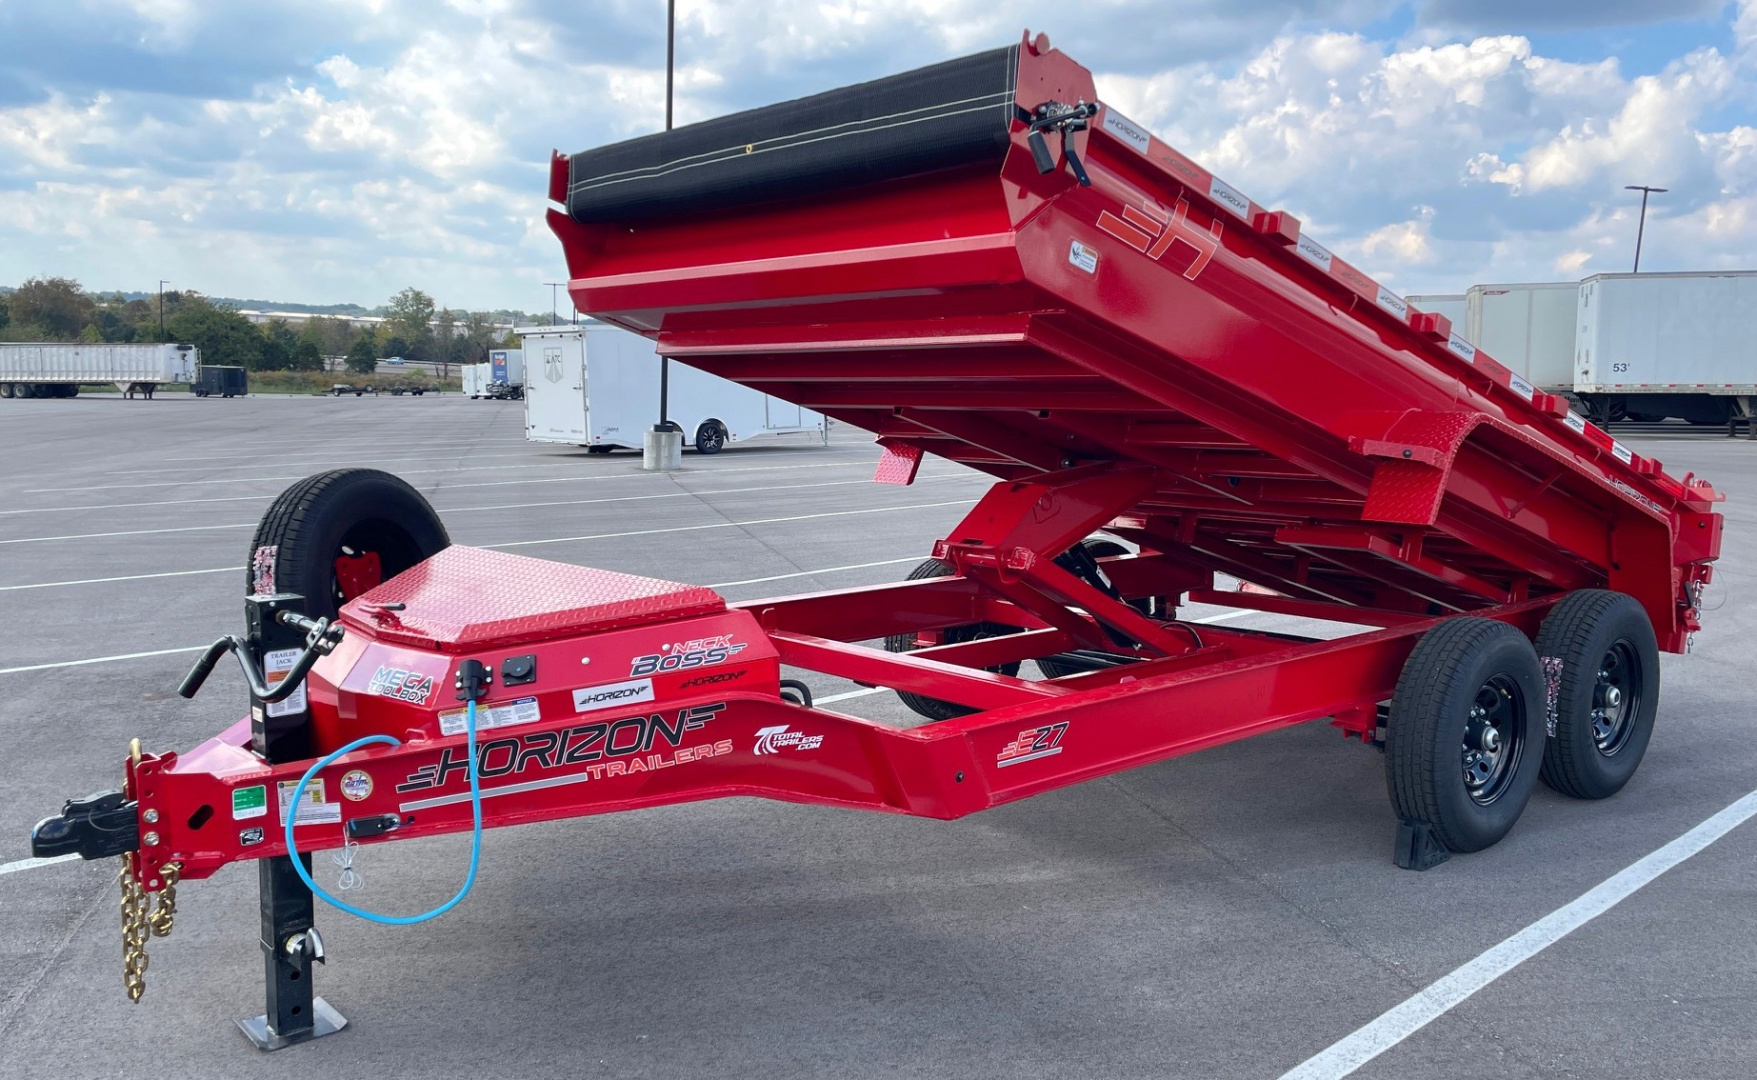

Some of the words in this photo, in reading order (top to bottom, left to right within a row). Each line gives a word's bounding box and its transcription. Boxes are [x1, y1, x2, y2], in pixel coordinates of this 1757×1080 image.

[1110, 118, 1144, 143] HORIZON
[1215, 188, 1244, 210] HORIZON
[1612, 362, 1630, 373] 53'
[271, 650, 297, 659] TRAILER
[671, 633, 733, 655] NECK
[276, 658, 292, 666] JACK
[630, 645, 730, 678] BOSS
[372, 665, 434, 694] MEGA
[685, 672, 742, 688] HORIZON
[367, 680, 428, 705] TOOLBOX
[586, 686, 643, 704] HORIZON
[772, 734, 824, 748] TRAILERS
[773, 731, 805, 741] TOTAL
[1013, 721, 1070, 757] E27
[434, 708, 690, 788] HORIZON
[586, 738, 734, 780] TRAILERS
